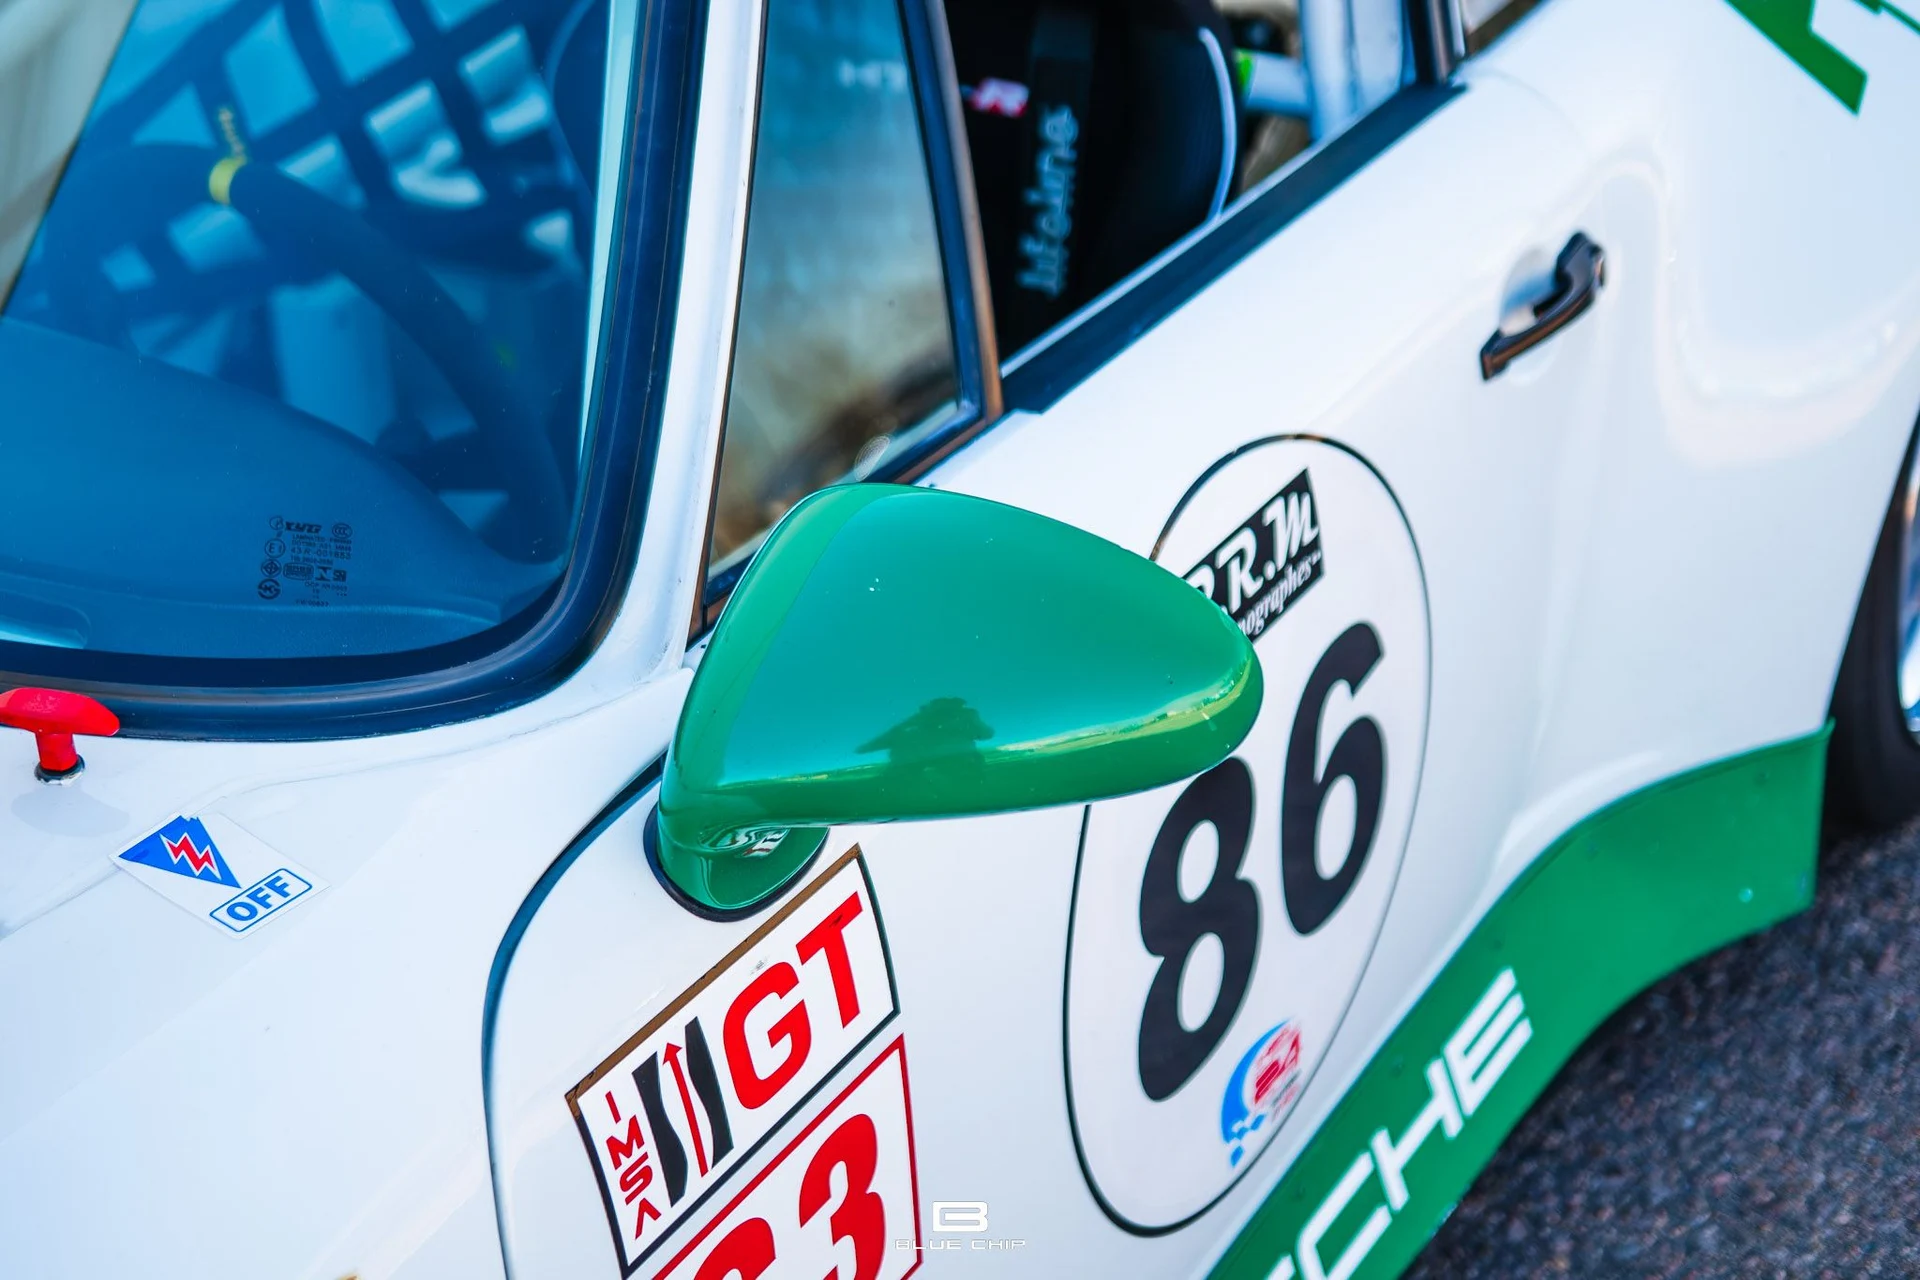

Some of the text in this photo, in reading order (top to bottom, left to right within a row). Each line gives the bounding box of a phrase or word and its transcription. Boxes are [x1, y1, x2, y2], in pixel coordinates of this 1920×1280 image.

[226, 875, 290, 922] OFF
[1138, 620, 1385, 1102] 86
[722, 890, 863, 1110] GT
[604, 1090, 662, 1241] IMSA
